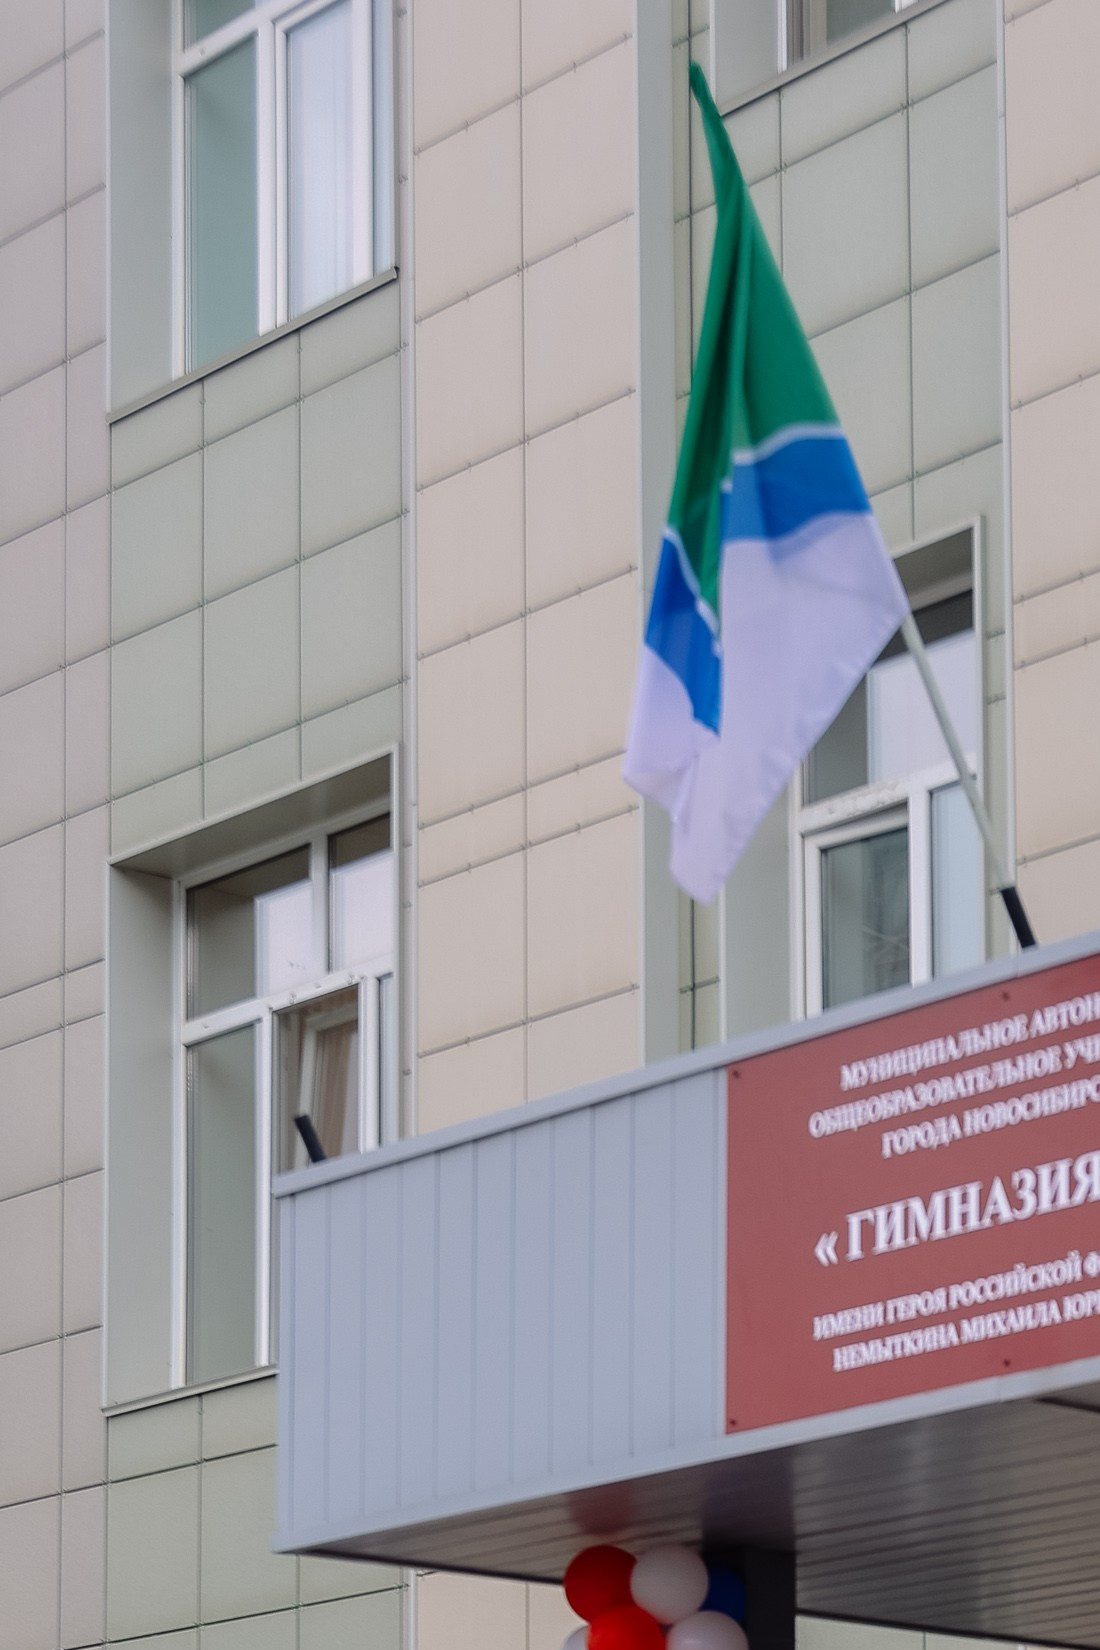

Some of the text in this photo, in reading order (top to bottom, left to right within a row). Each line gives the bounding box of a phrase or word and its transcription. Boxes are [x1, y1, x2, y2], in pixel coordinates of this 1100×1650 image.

[808, 1044, 1062, 1138] ОБЩЕОБРАЗОВАТЕЛЬНОЕ
[840, 1013, 1029, 1091] МУНИЦИПАЛЬНОЕ
[881, 1114, 962, 1159] ГОРОДА
[813, 1301, 885, 1341] ИМЕНИ
[885, 1286, 947, 1324] ГЕРОЯ
[948, 1249, 1083, 1311] РОССИЙСКОЙ
[832, 1321, 960, 1373] НЕМЫТКИНА
[960, 1297, 1062, 1345] МИХАИЛА
